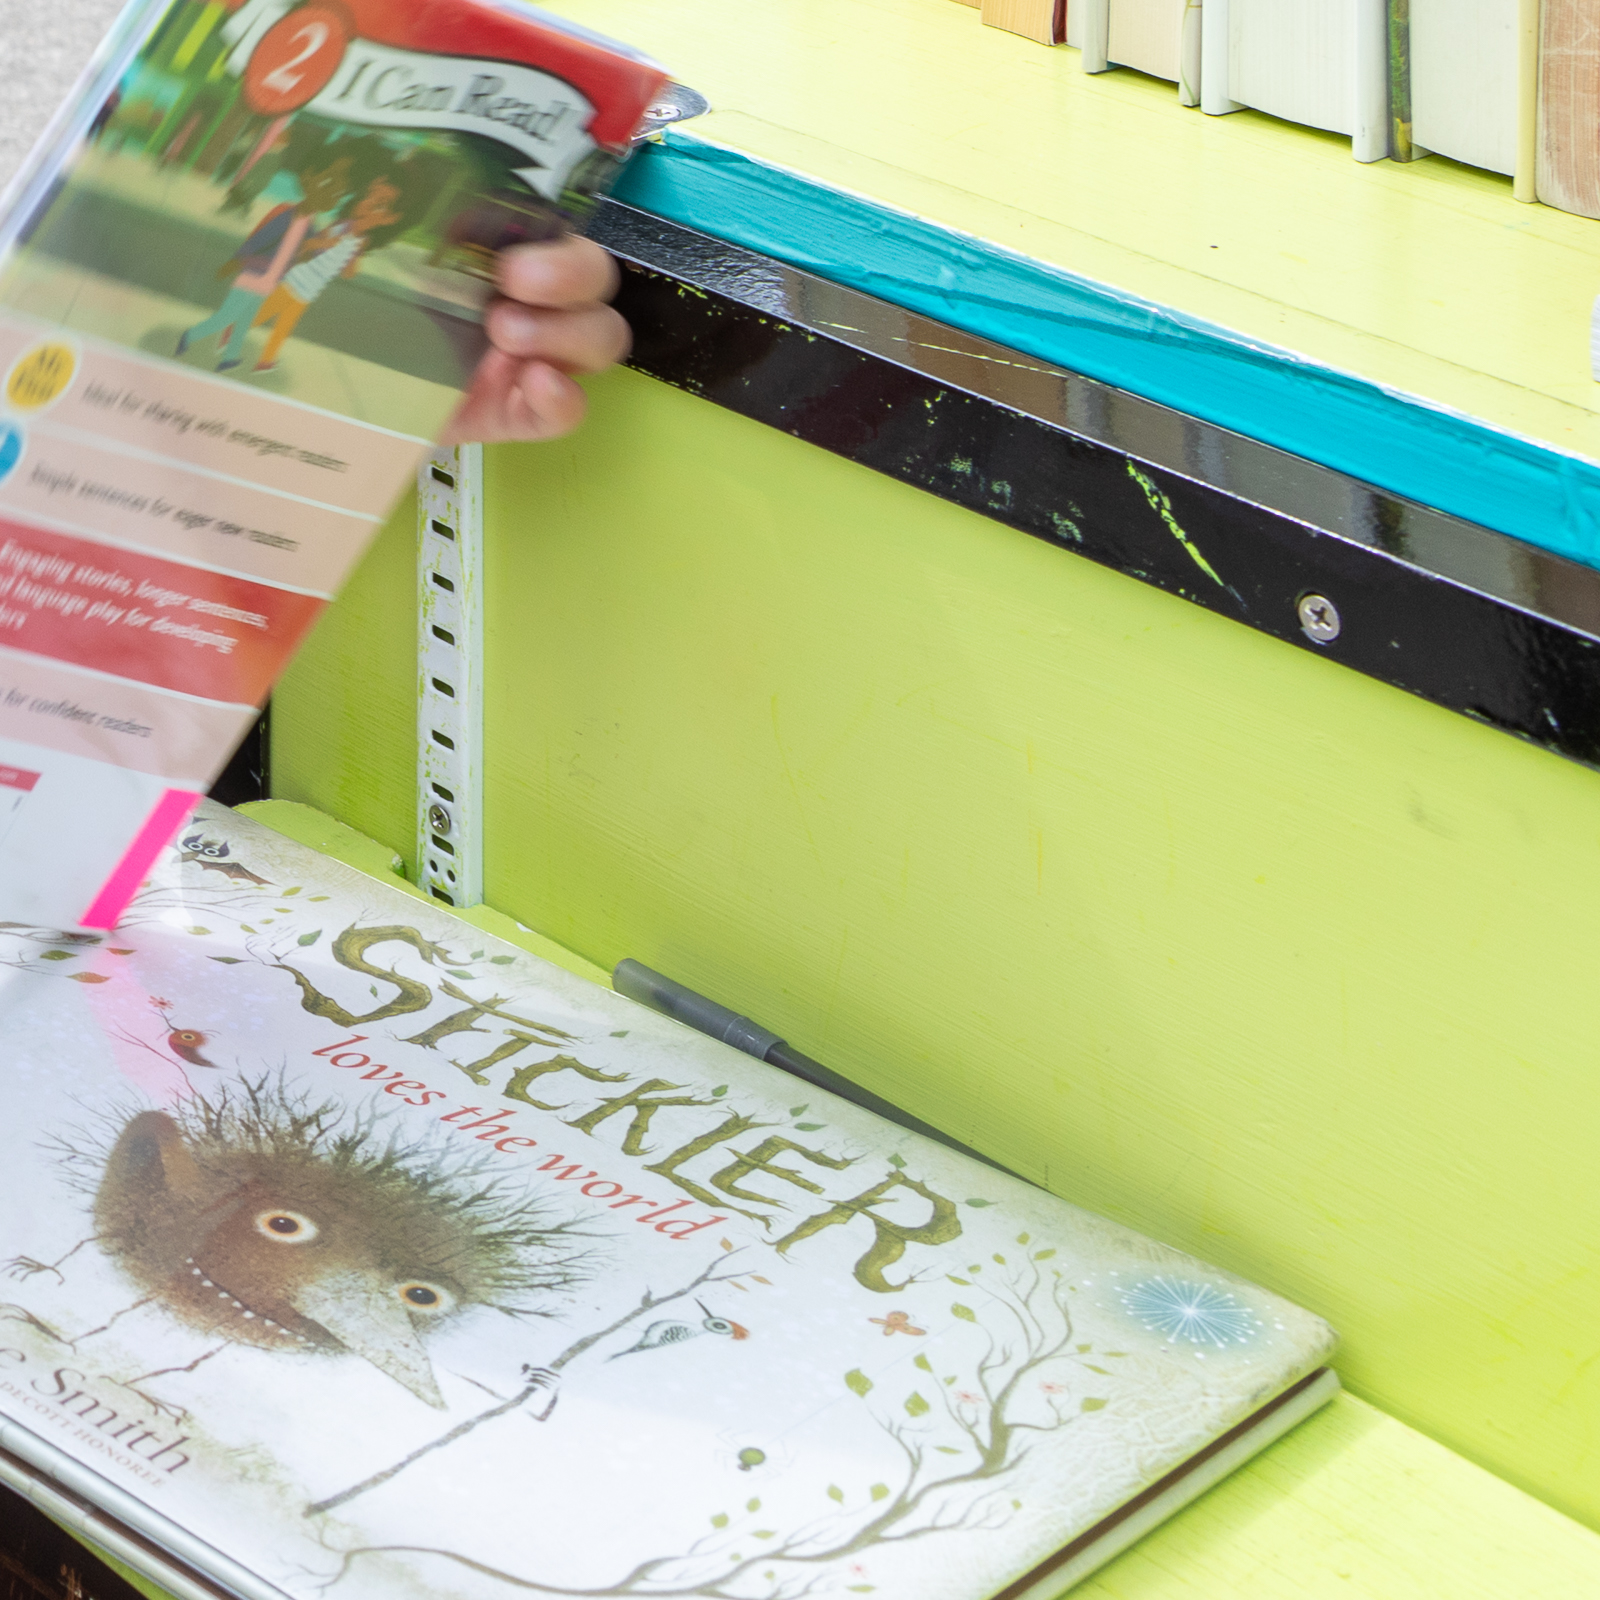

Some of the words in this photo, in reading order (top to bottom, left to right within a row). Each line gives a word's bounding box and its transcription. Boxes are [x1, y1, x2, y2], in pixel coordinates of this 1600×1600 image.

[261, 21, 329, 94] 2
[362, 64, 456, 114] Can
[278, 922, 965, 1293] STICKLER
[311, 1033, 447, 1108] loves
[440, 1099, 538, 1155] the
[535, 1151, 730, 1242] world
[30, 1367, 192, 1475] Smith
[73, 1424, 169, 1490] HONOREE
